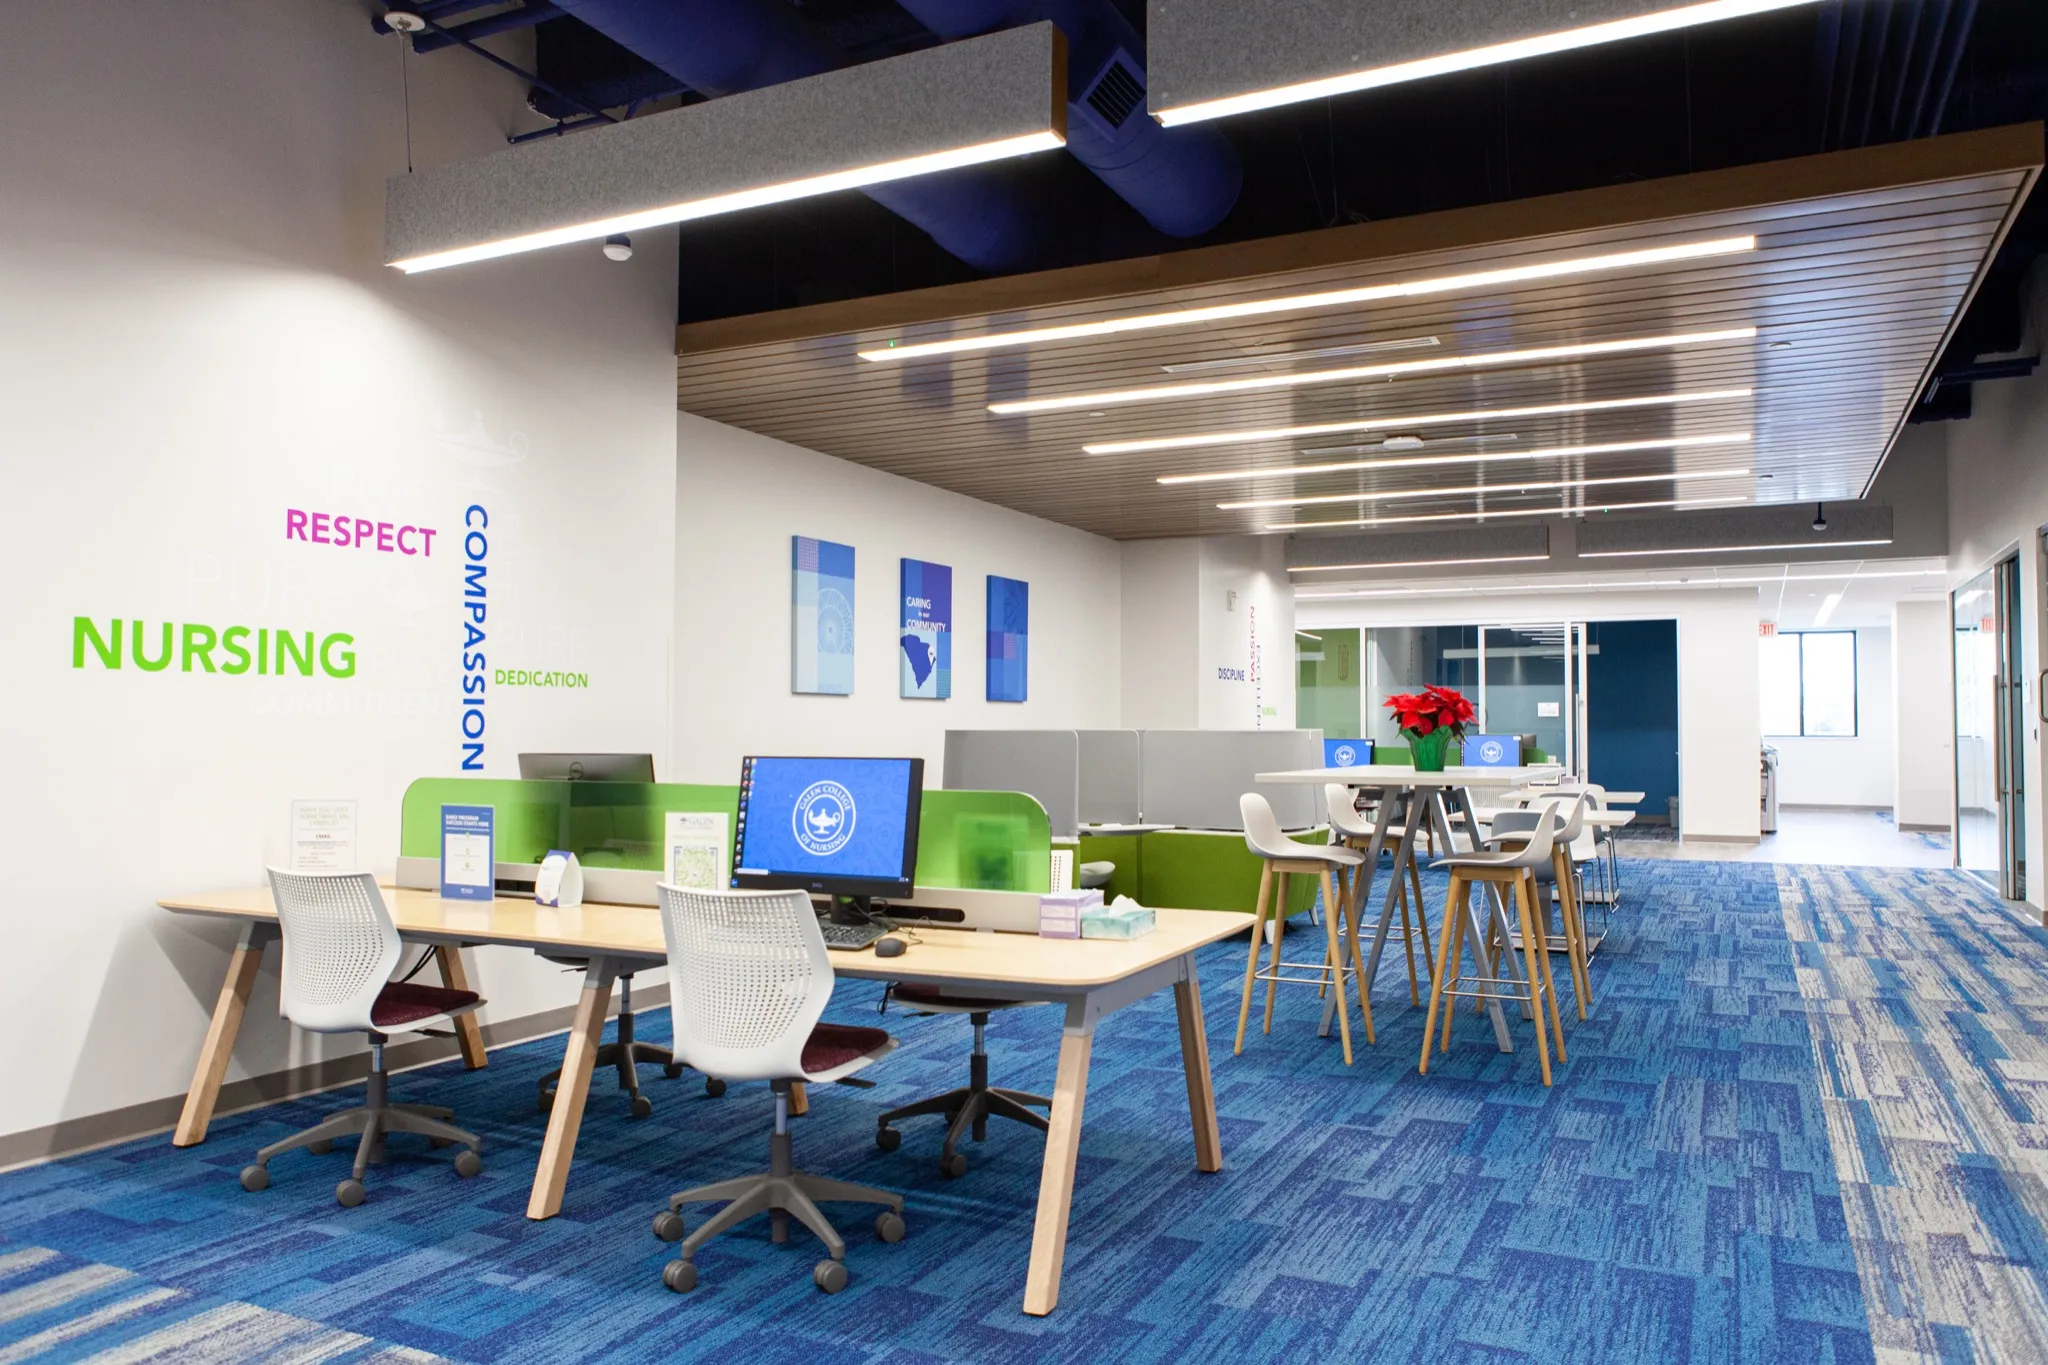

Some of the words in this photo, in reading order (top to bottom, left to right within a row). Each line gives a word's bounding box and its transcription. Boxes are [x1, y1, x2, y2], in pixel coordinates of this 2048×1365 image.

[286, 508, 437, 557] RESPECT
[906, 596, 931, 610] CARING
[906, 618, 946, 633] COMMUNITY
[1759, 624, 1774, 636] EXIT
[73, 616, 357, 679] NURSING
[461, 504, 488, 771] COMPASSION
[494, 668, 590, 689] DEDICATION
[1218, 667, 1245, 682] DISCIPLINE
[799, 786, 822, 810] GALEN
[822, 785, 851, 811] COLLEGE
[801, 833, 811, 845] OF
[810, 834, 846, 852] NURSING
